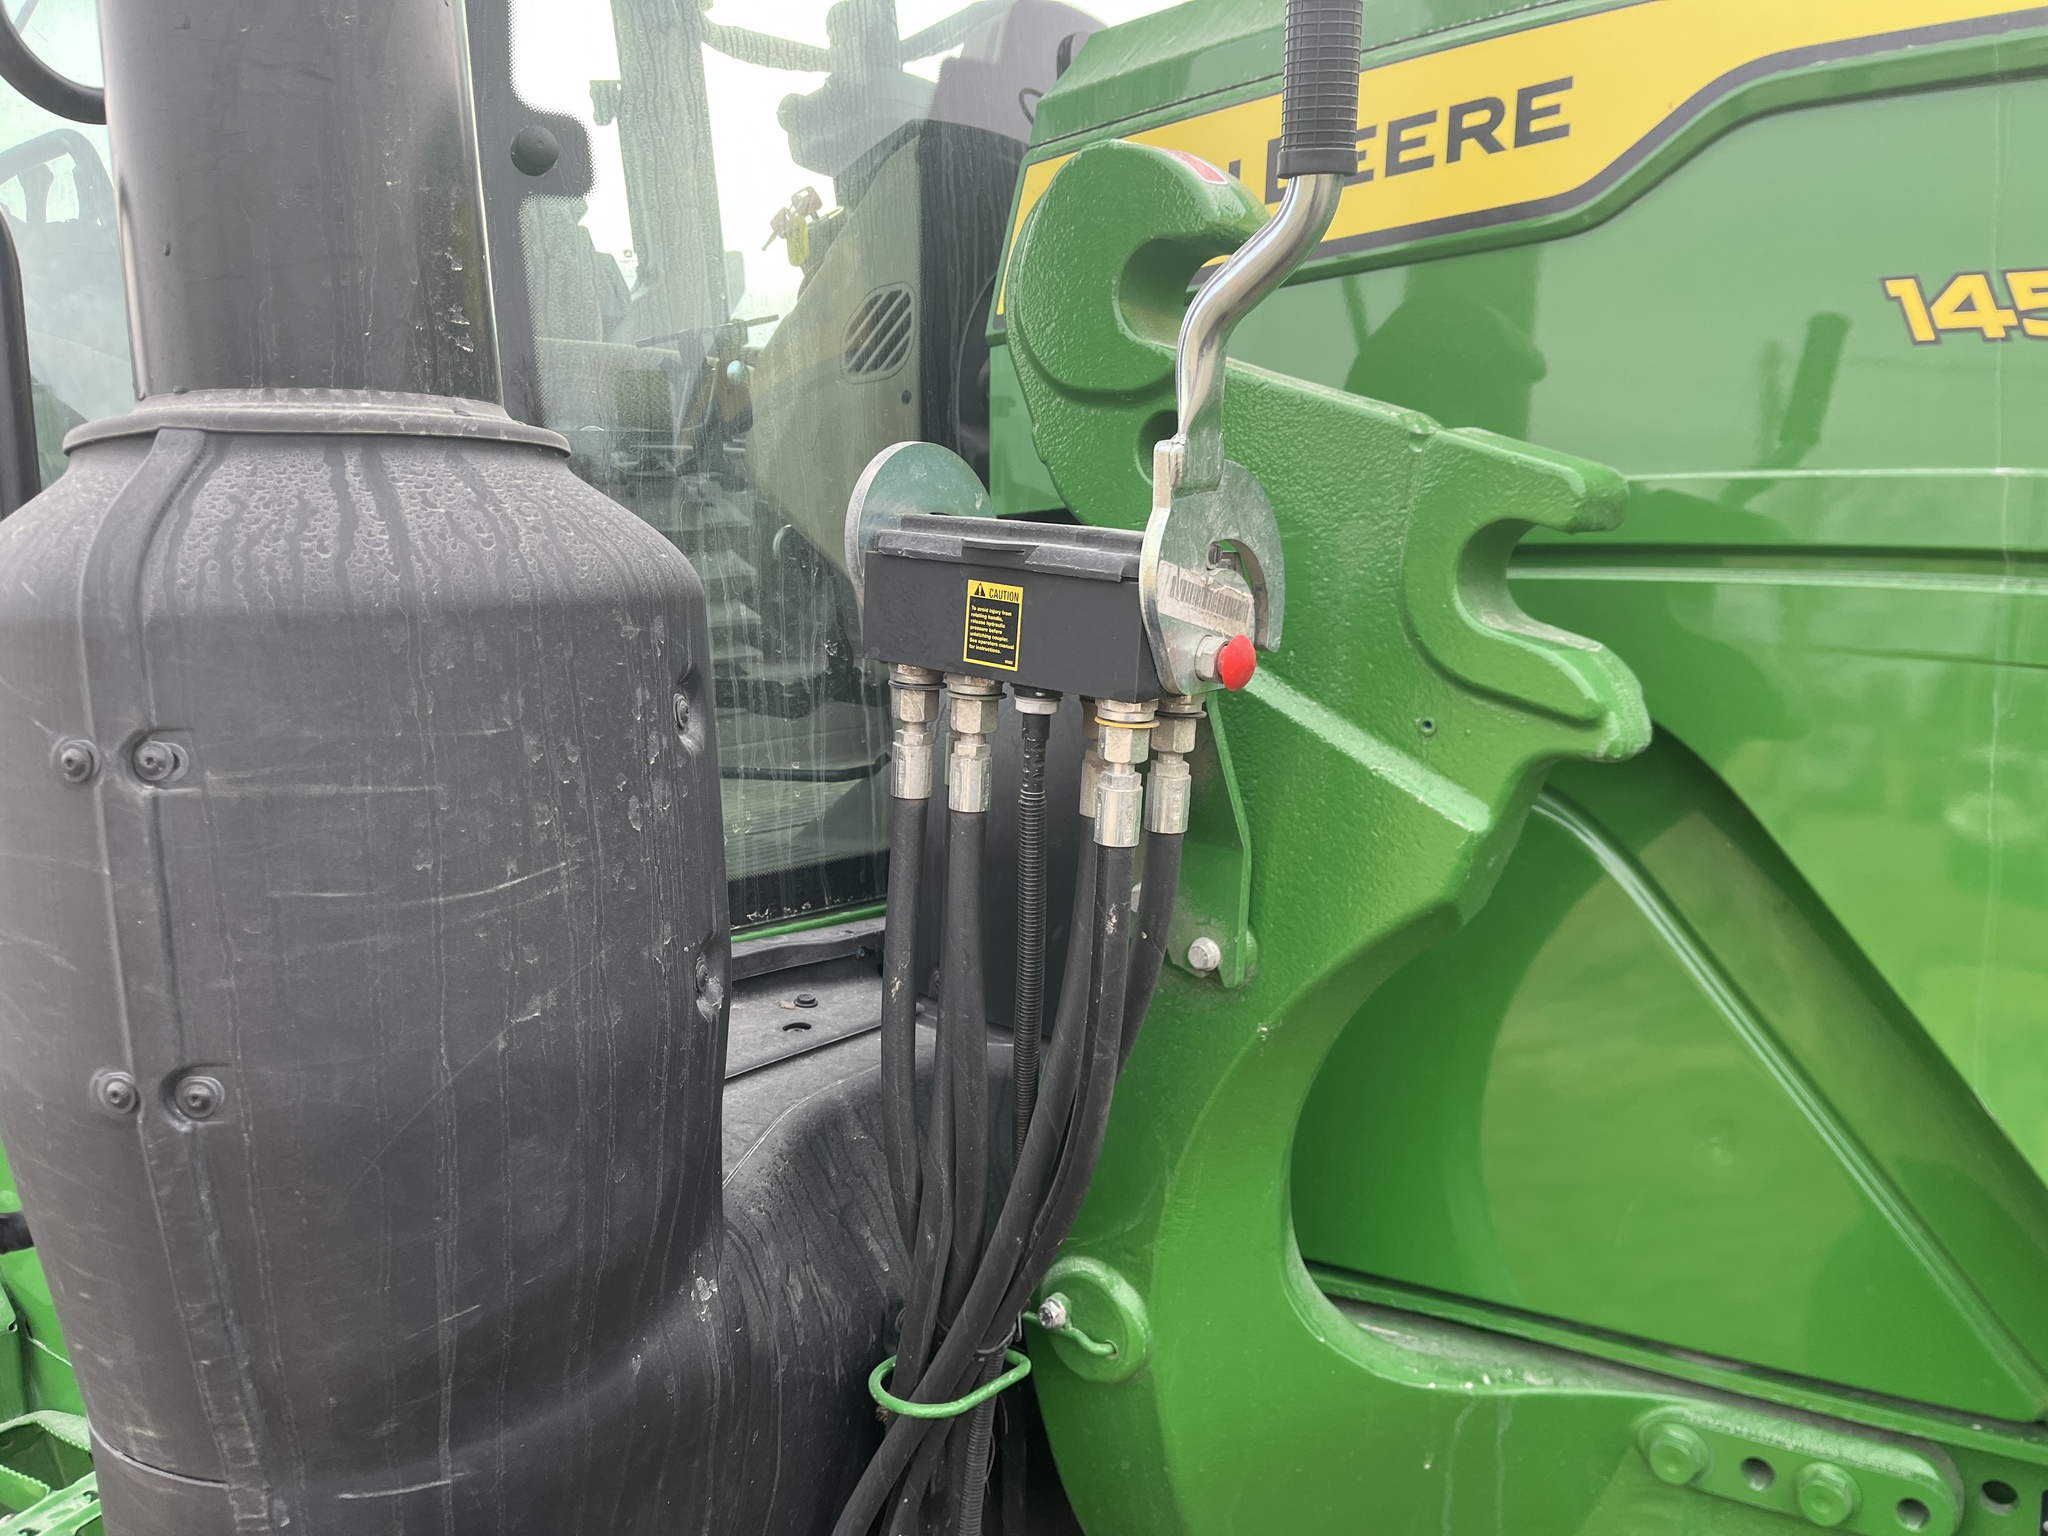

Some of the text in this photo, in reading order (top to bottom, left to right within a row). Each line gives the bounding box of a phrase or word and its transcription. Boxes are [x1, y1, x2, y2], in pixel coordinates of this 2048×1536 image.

[989, 588, 1019, 602] CAUTION
[989, 608, 1001, 616] injury
[986, 621, 1005, 629] hydraulic
